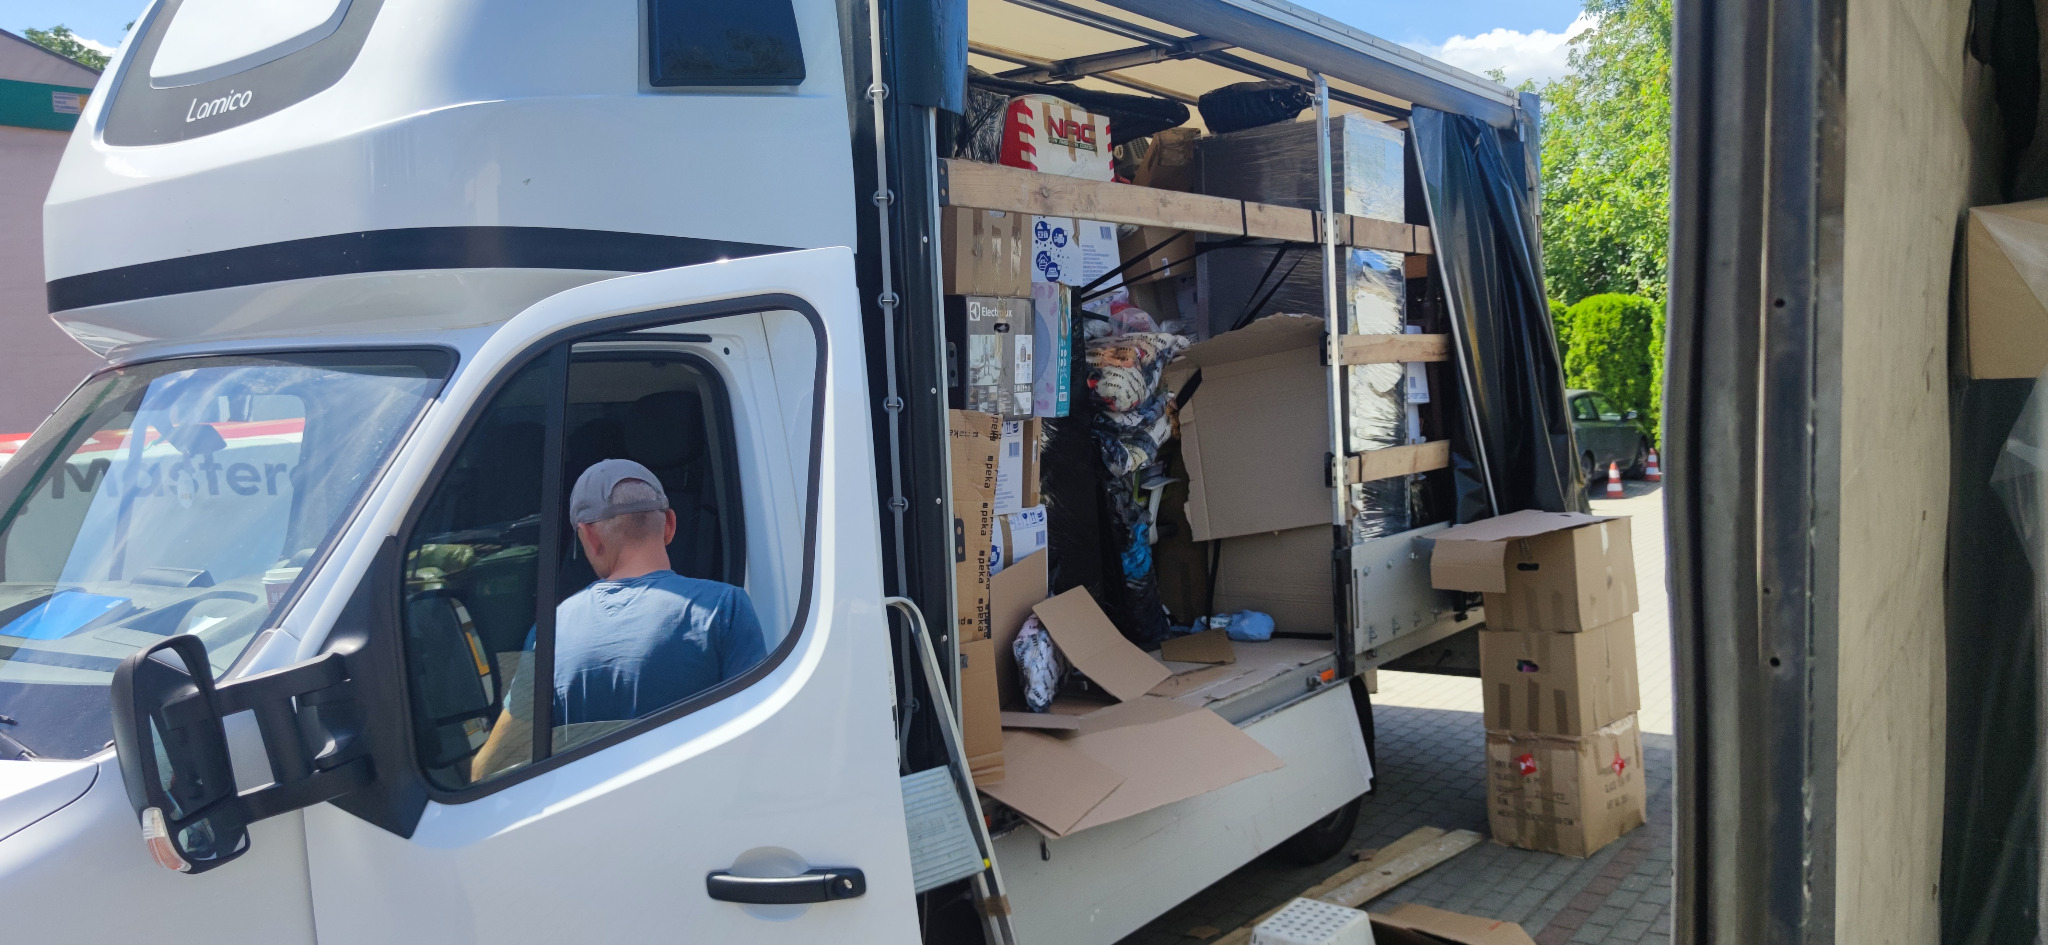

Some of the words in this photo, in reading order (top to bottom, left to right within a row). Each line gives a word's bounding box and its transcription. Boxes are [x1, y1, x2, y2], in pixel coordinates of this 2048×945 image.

[186, 89, 253, 123] Lamico
[1048, 116, 1095, 144] NAC
[984, 463, 994, 489] peka
[980, 510, 989, 536] peka
[977, 558, 986, 584] peka
[976, 606, 985, 632] peka
